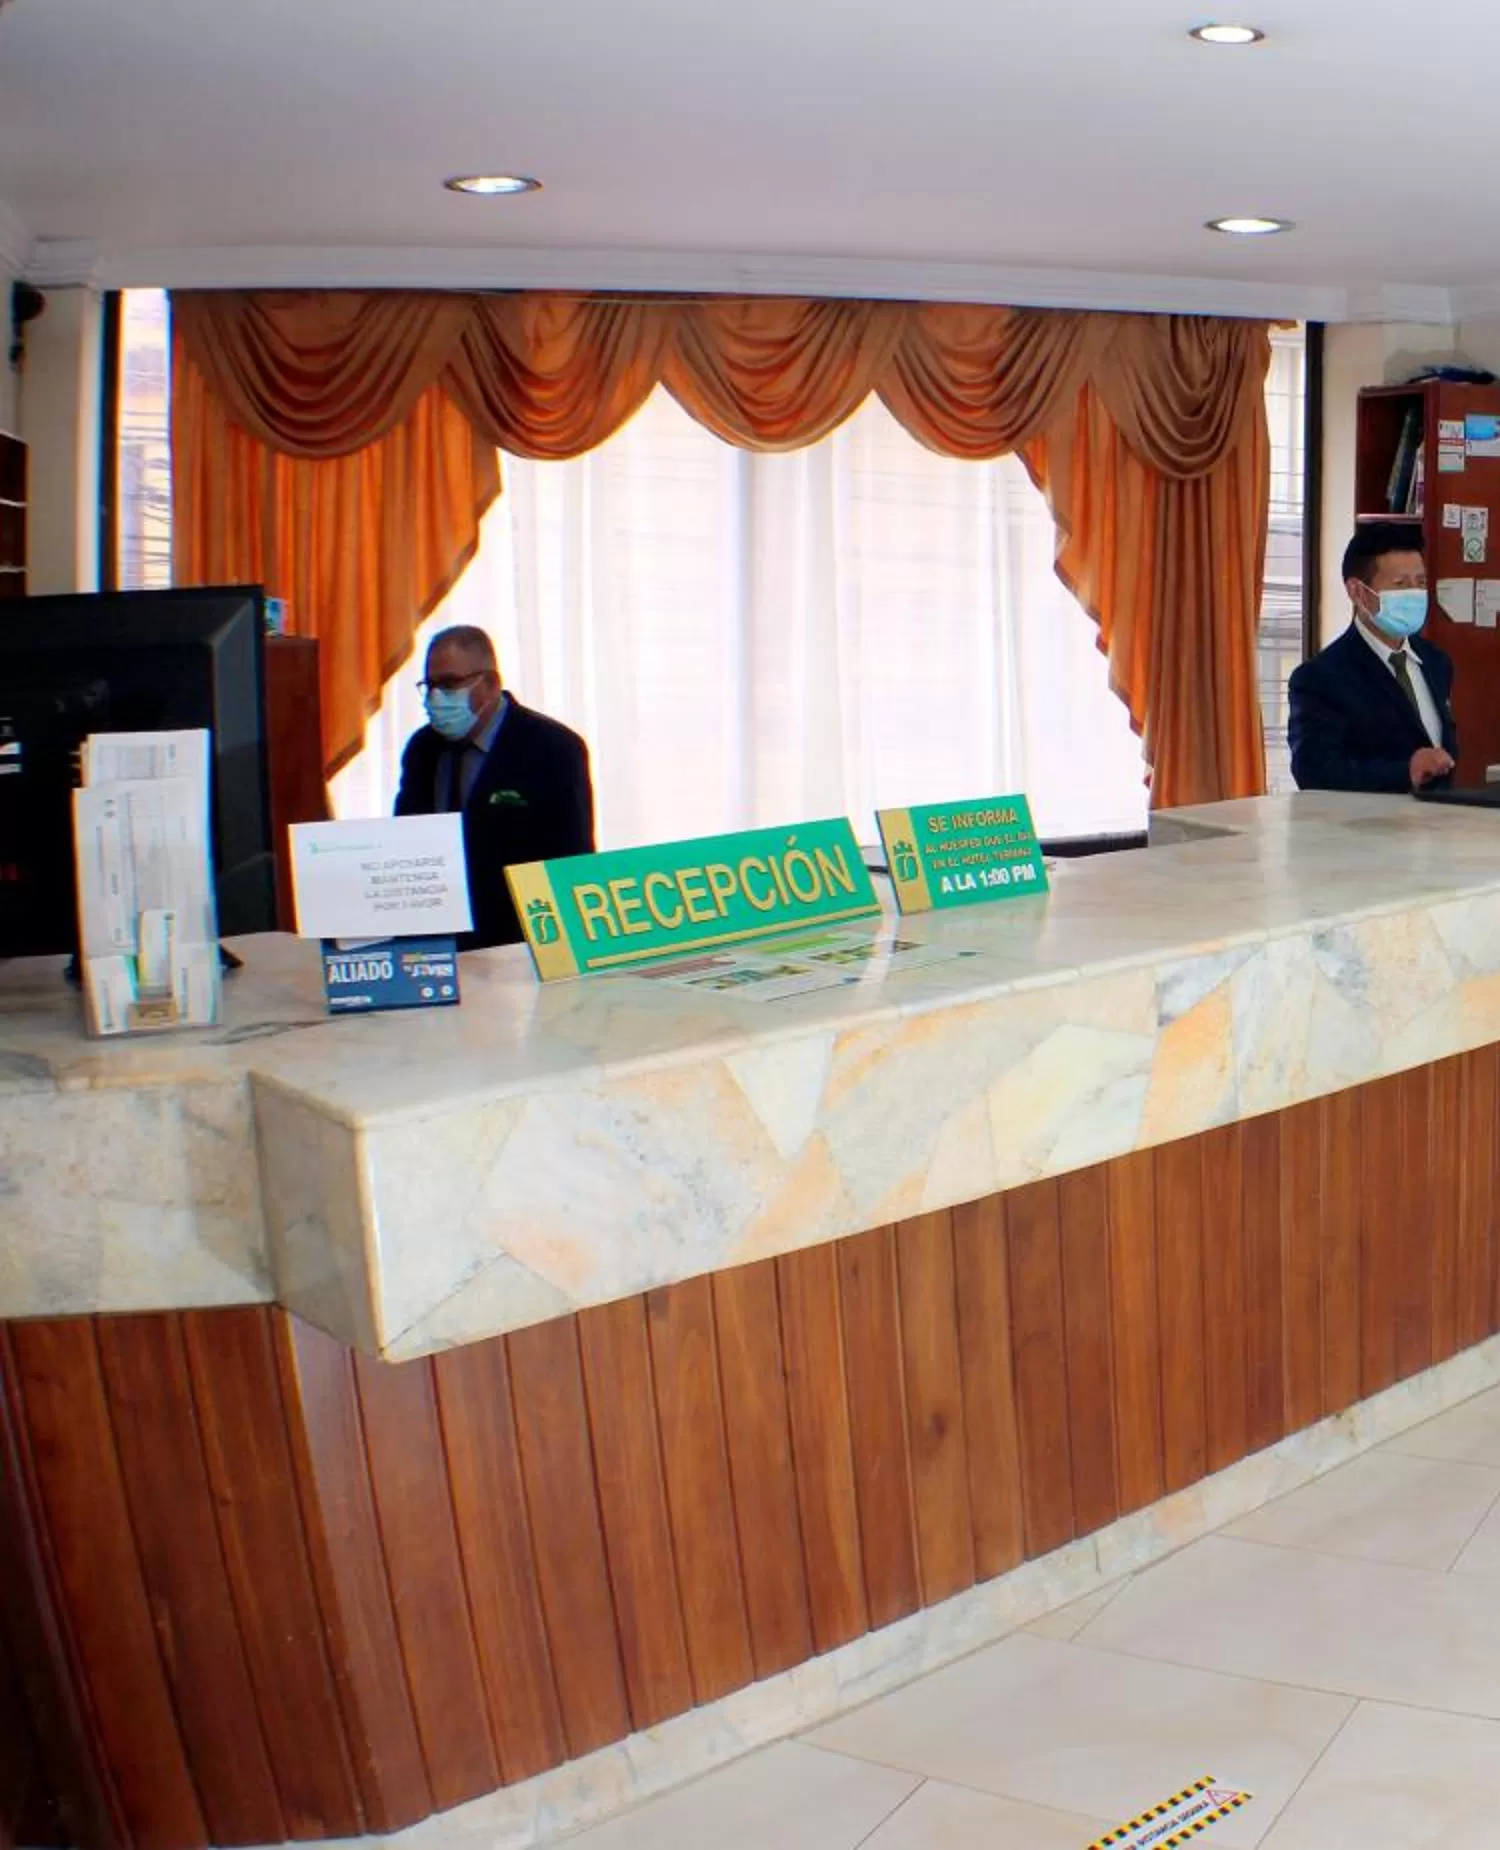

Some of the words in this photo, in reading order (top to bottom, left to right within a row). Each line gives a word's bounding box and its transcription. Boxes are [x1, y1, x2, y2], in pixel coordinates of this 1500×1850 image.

[928, 816, 949, 833] SE
[951, 808, 1017, 829] INFORMA
[572, 834, 857, 941] RECEPCIÓN
[941, 875, 954, 893] A
[954, 872, 977, 891] LA
[979, 867, 1011, 888] 1:00
[1011, 863, 1037, 882] PM
[328, 960, 394, 984] ALIADO
